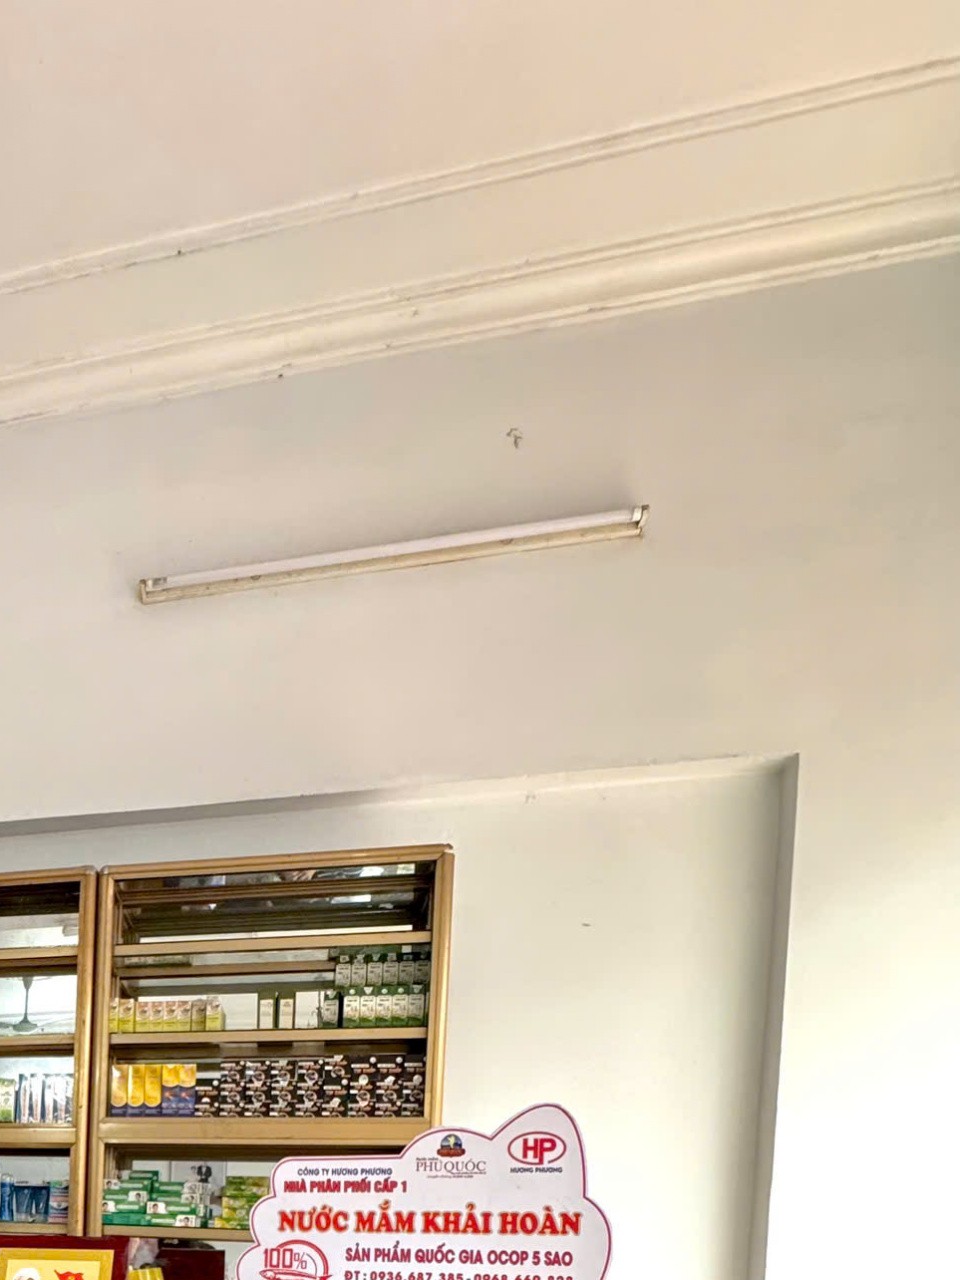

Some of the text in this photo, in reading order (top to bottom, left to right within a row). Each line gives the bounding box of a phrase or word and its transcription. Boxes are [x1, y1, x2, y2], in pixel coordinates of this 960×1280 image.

[522, 1138, 557, 1165] HP
[297, 1166, 319, 1176] CÔNG
[321, 1167, 330, 1176] TY
[284, 1176, 408, 1193] NHÀ PHÂN PHỐI CẤP 1
[278, 1200, 584, 1237] NƯỚC MẮM KHẢI HOÀN
[263, 1247, 308, 1269] 100%
[345, 1240, 574, 1268] SẢN PHẨM QUỐC GIA OCOP 5 SAO
